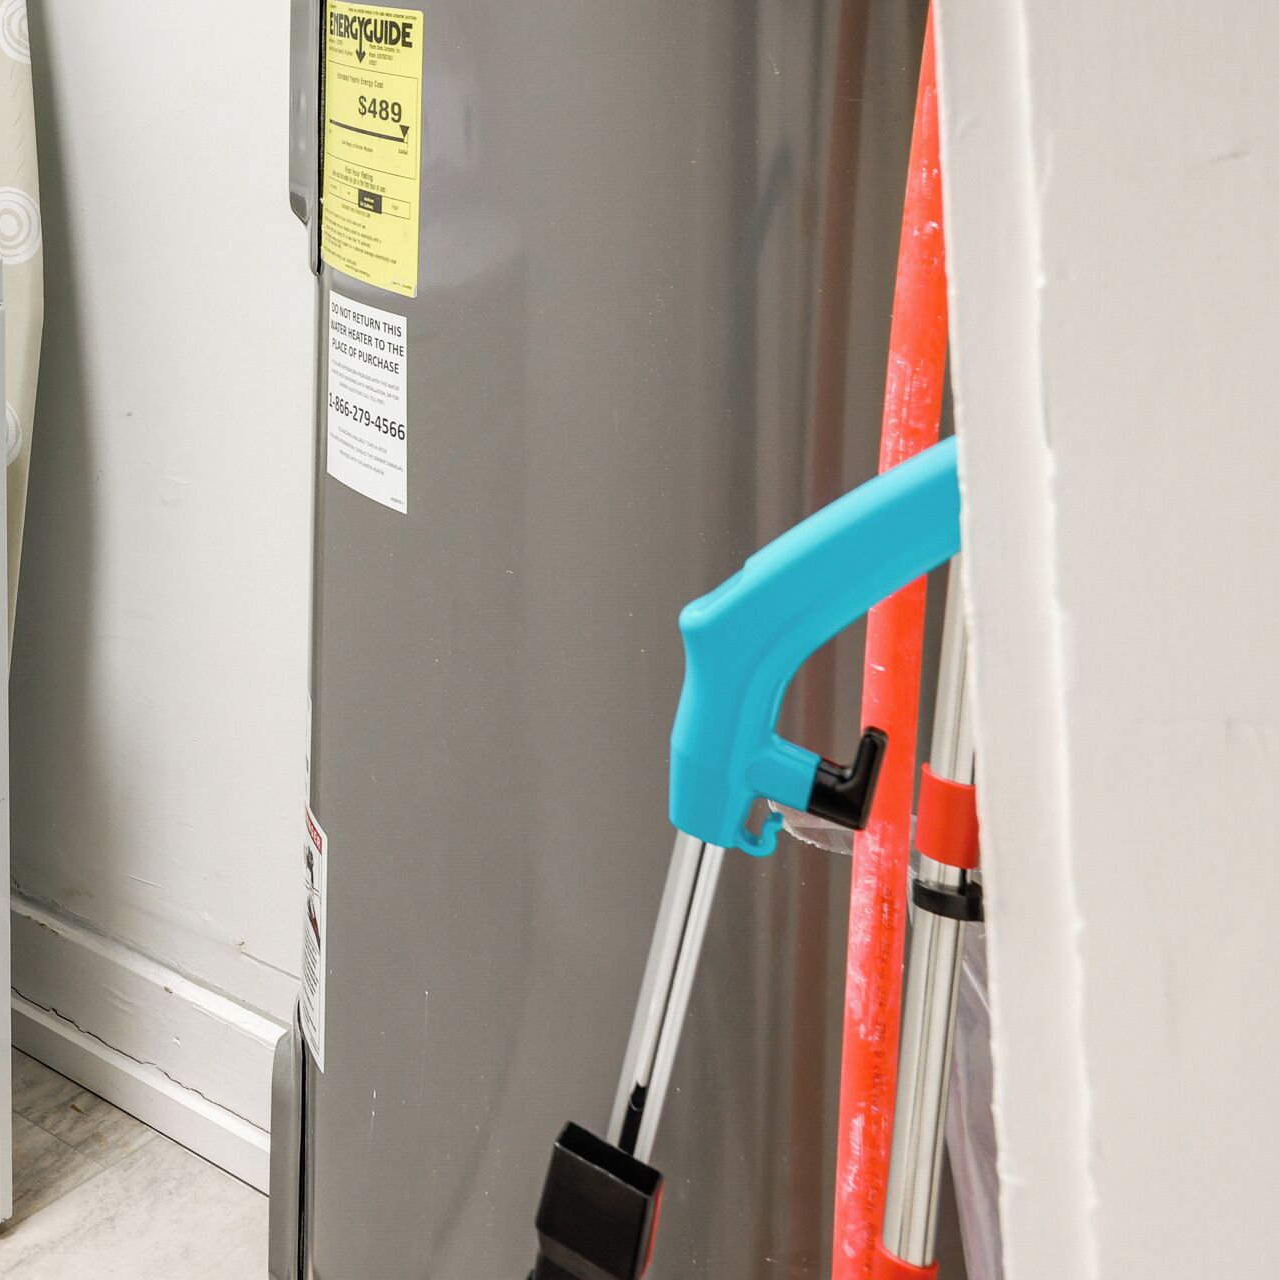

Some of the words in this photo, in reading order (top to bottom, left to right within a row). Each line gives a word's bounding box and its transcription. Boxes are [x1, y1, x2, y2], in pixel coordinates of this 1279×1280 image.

[330, 11, 413, 49] ENERGYGUIDE
[360, 78, 373, 88] Energy
[358, 95, 402, 123] $489
[330, 319, 347, 337] WATER
[348, 327, 372, 347] HEATER
[374, 337, 385, 351] TO
[387, 341, 405, 357] THE
[331, 302, 339, 314] DO
[340, 305, 351, 320] NOT
[352, 311, 381, 331] RETURN
[382, 321, 402, 337] THIS
[332, 337, 347, 354] PLACE
[348, 346, 357, 358] OF
[358, 349, 400, 375] PURCHASE
[329, 392, 405, 440] 1-866-279-4566
